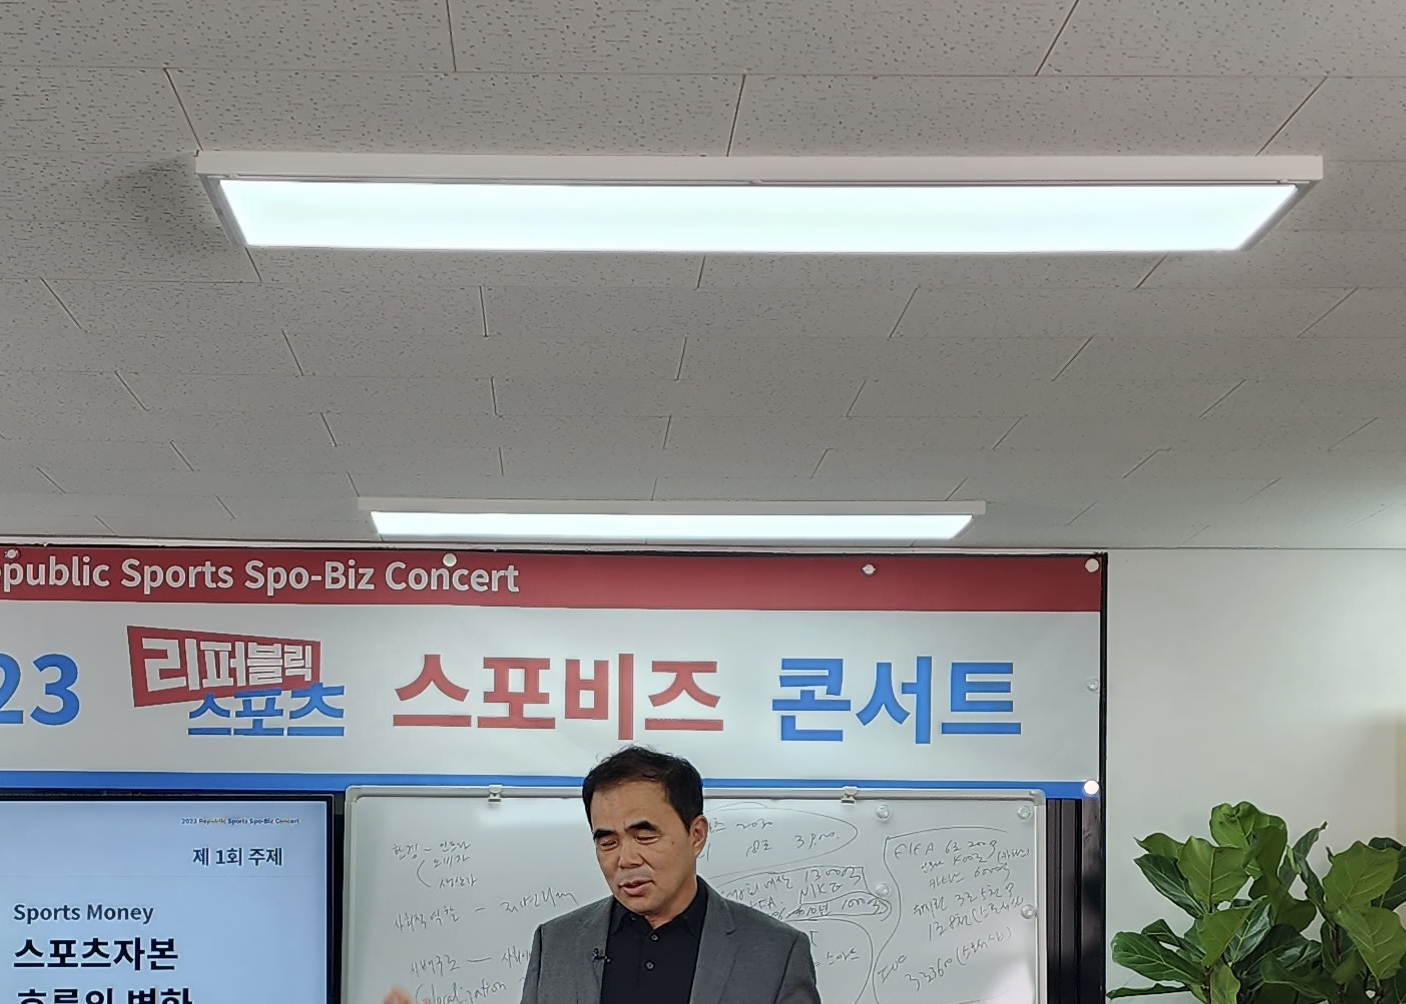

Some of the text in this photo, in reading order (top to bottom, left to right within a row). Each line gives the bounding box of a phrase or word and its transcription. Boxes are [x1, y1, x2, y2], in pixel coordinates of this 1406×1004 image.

[121, 558, 233, 595] Sports
[245, 559, 375, 596] Spo-Biz
[385, 561, 520, 593] Concert
[141, 637, 312, 692] 리퍼블릭
[188, 681, 345, 737] 스포츠
[393, 653, 1022, 745] 스포비즈 콘서트
[193, 847, 282, 866] 제 1회 주제
[13, 904, 154, 925] Sports Money
[13, 937, 178, 971] 스포츠자본
